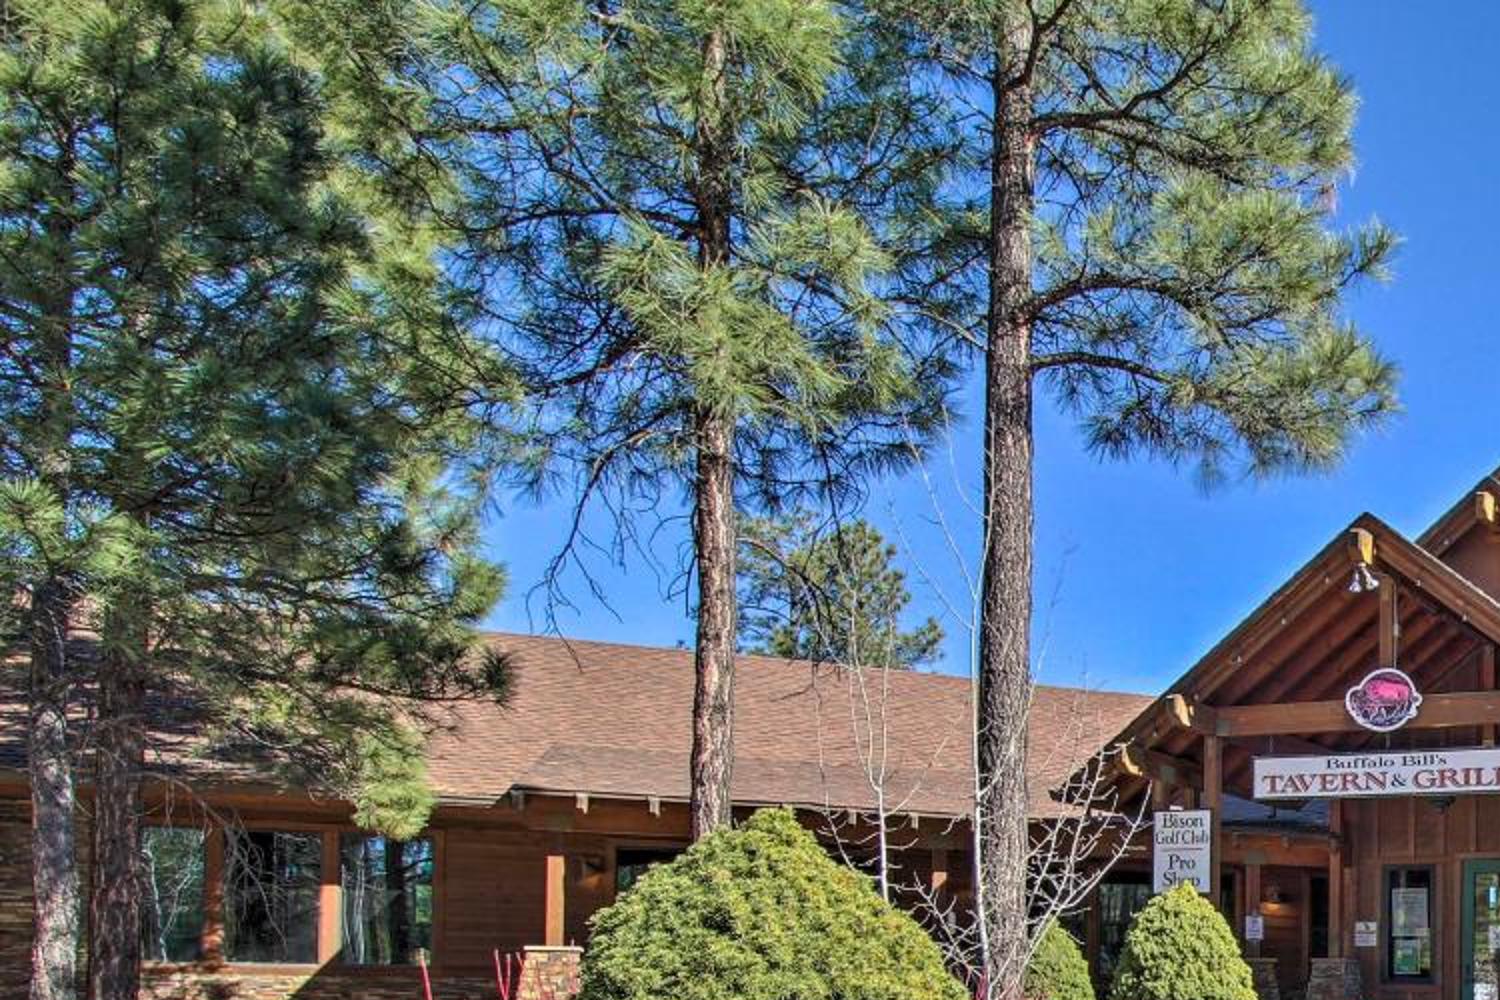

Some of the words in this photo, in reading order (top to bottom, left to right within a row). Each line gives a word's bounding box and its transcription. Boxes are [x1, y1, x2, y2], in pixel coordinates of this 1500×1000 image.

[1326, 756, 1396, 769] Buffalo
[1402, 754, 1448, 767] Bill's
[1262, 771, 1388, 794] TAVERN
[1391, 773, 1406, 787] &
[1162, 813, 1204, 829] Bison
[1155, 829, 1180, 845] Golf
[1181, 829, 1209, 845] Club
[1167, 853, 1197, 870] Pro
